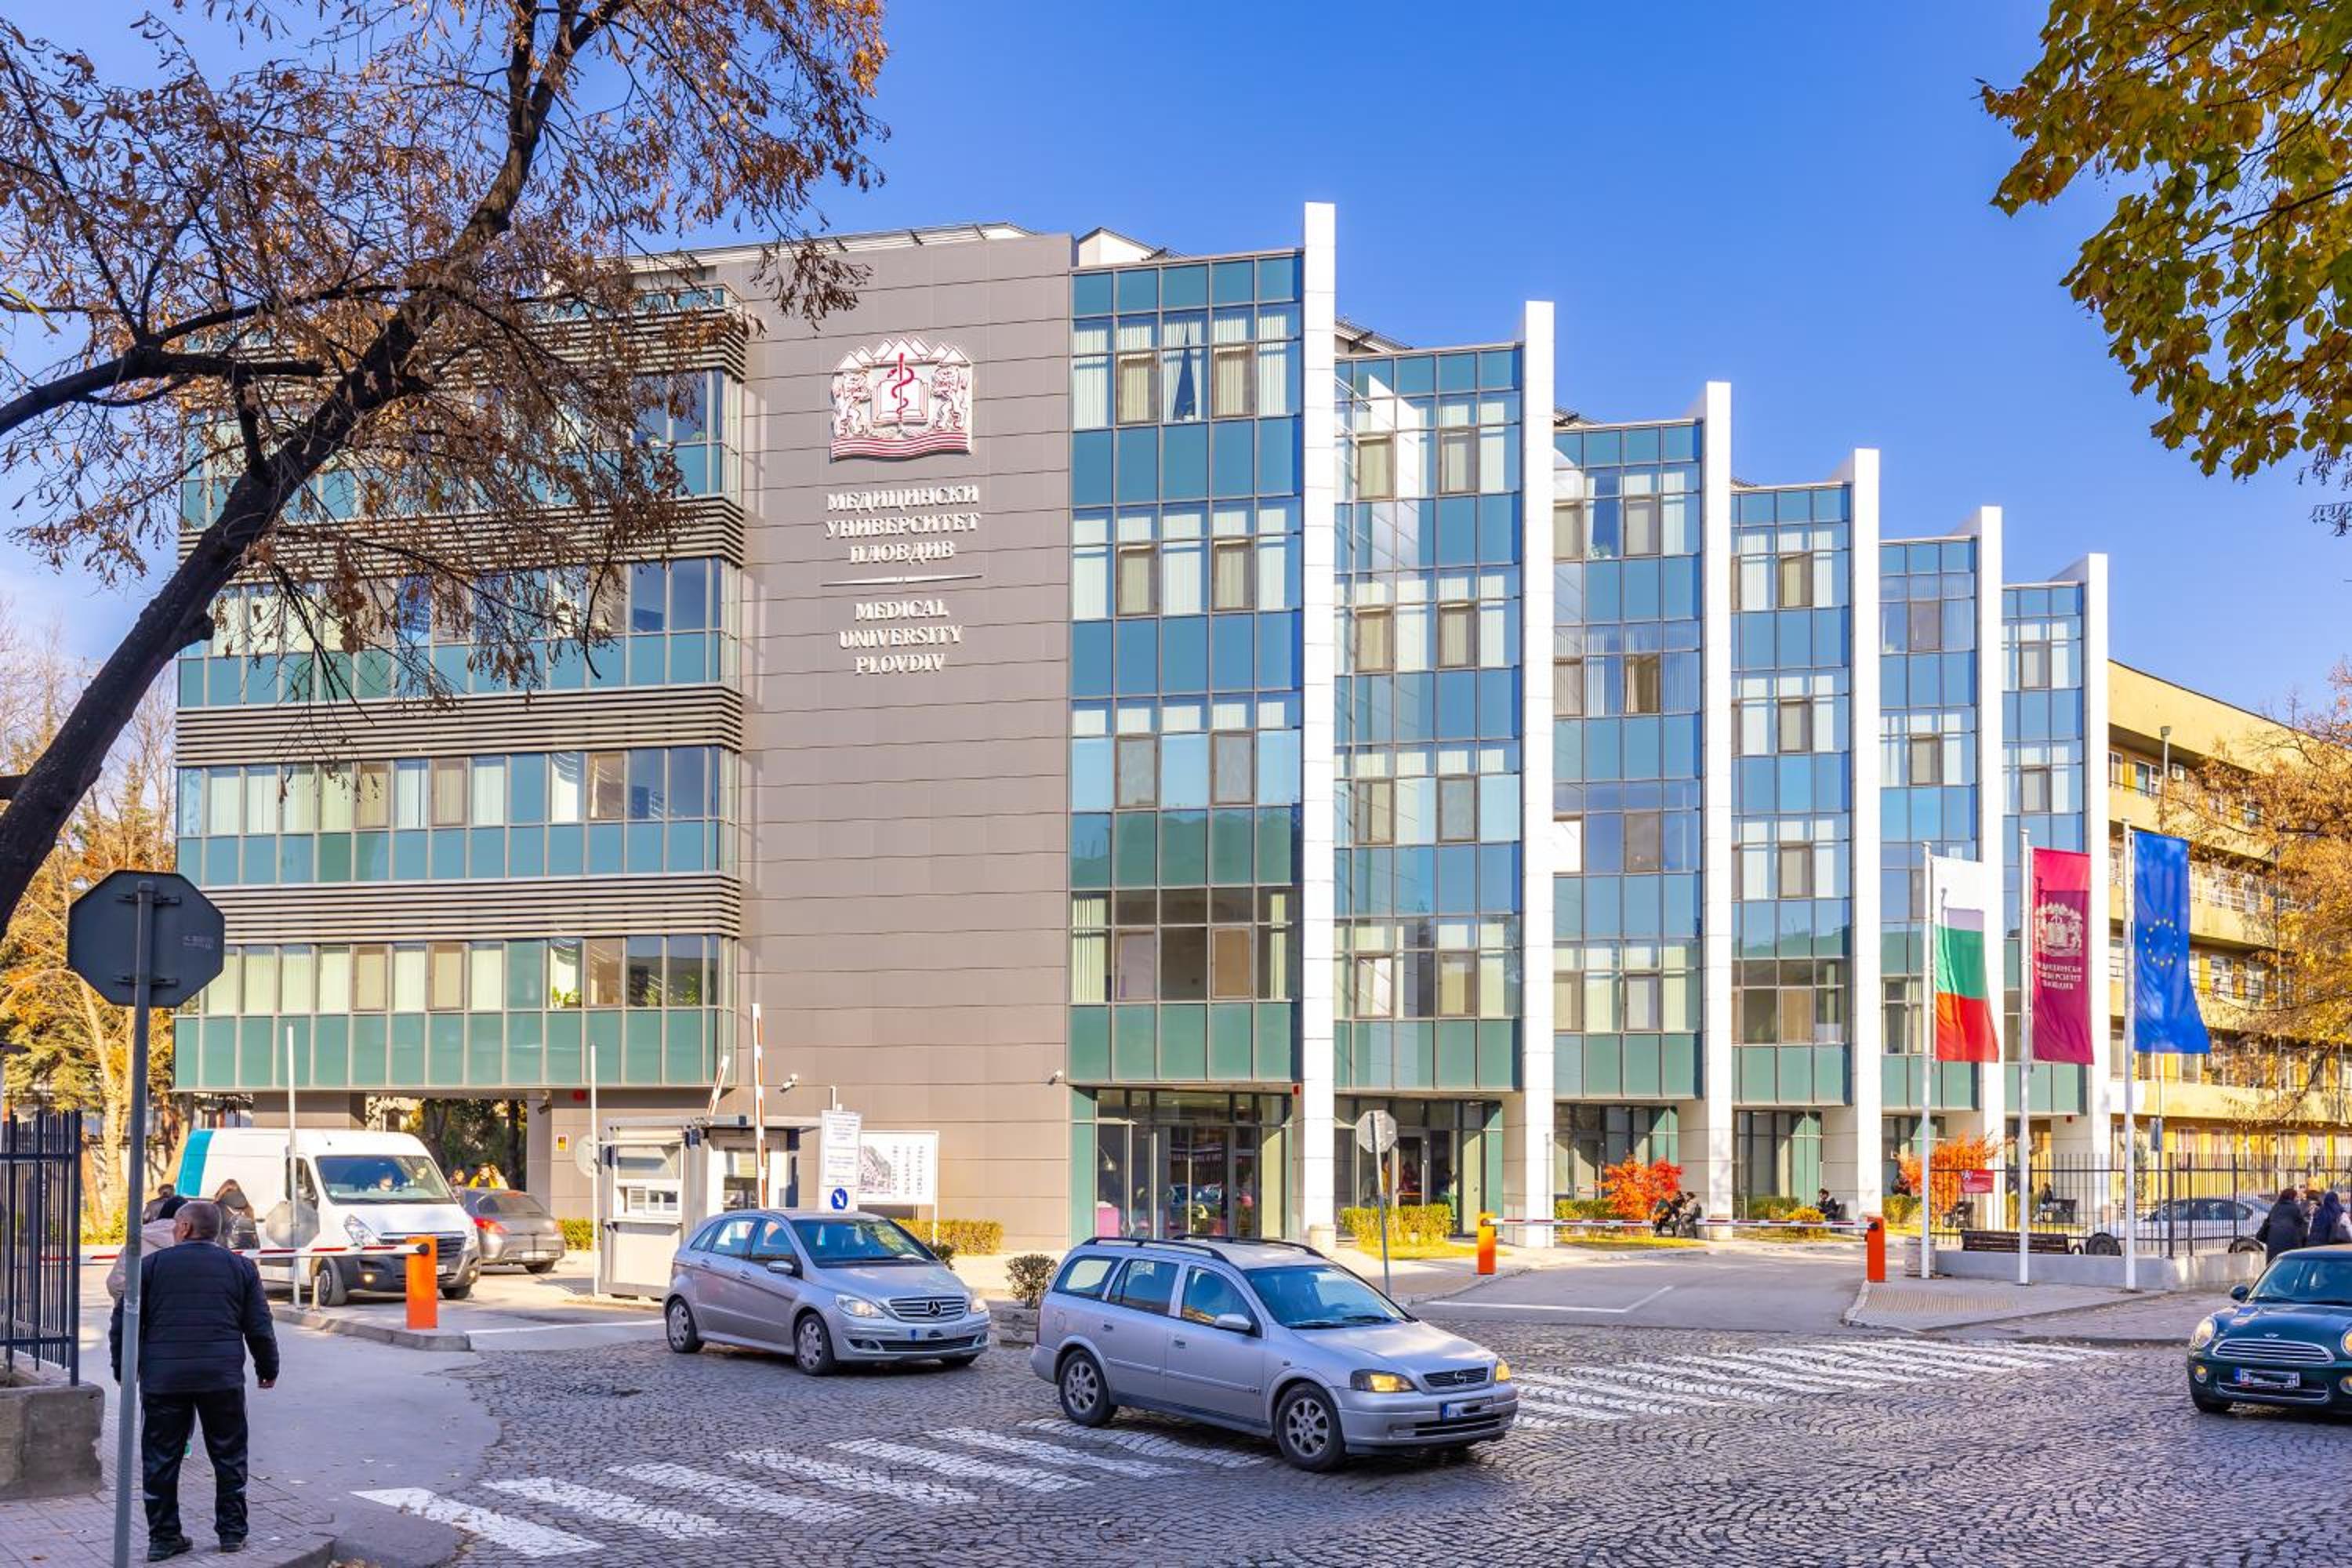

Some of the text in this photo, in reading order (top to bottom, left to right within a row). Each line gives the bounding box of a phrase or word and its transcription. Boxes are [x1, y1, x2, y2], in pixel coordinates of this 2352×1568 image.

[827, 485, 979, 514] МЕДИЦИНСКИ
[825, 513, 981, 539] УНИВЕРСИТЕТ
[849, 541, 955, 564] ПЛОВДИВ
[855, 600, 949, 621] MEDICAL
[839, 626, 963, 649] UNIVERSITY
[854, 654, 945, 676] PLOVDIV
